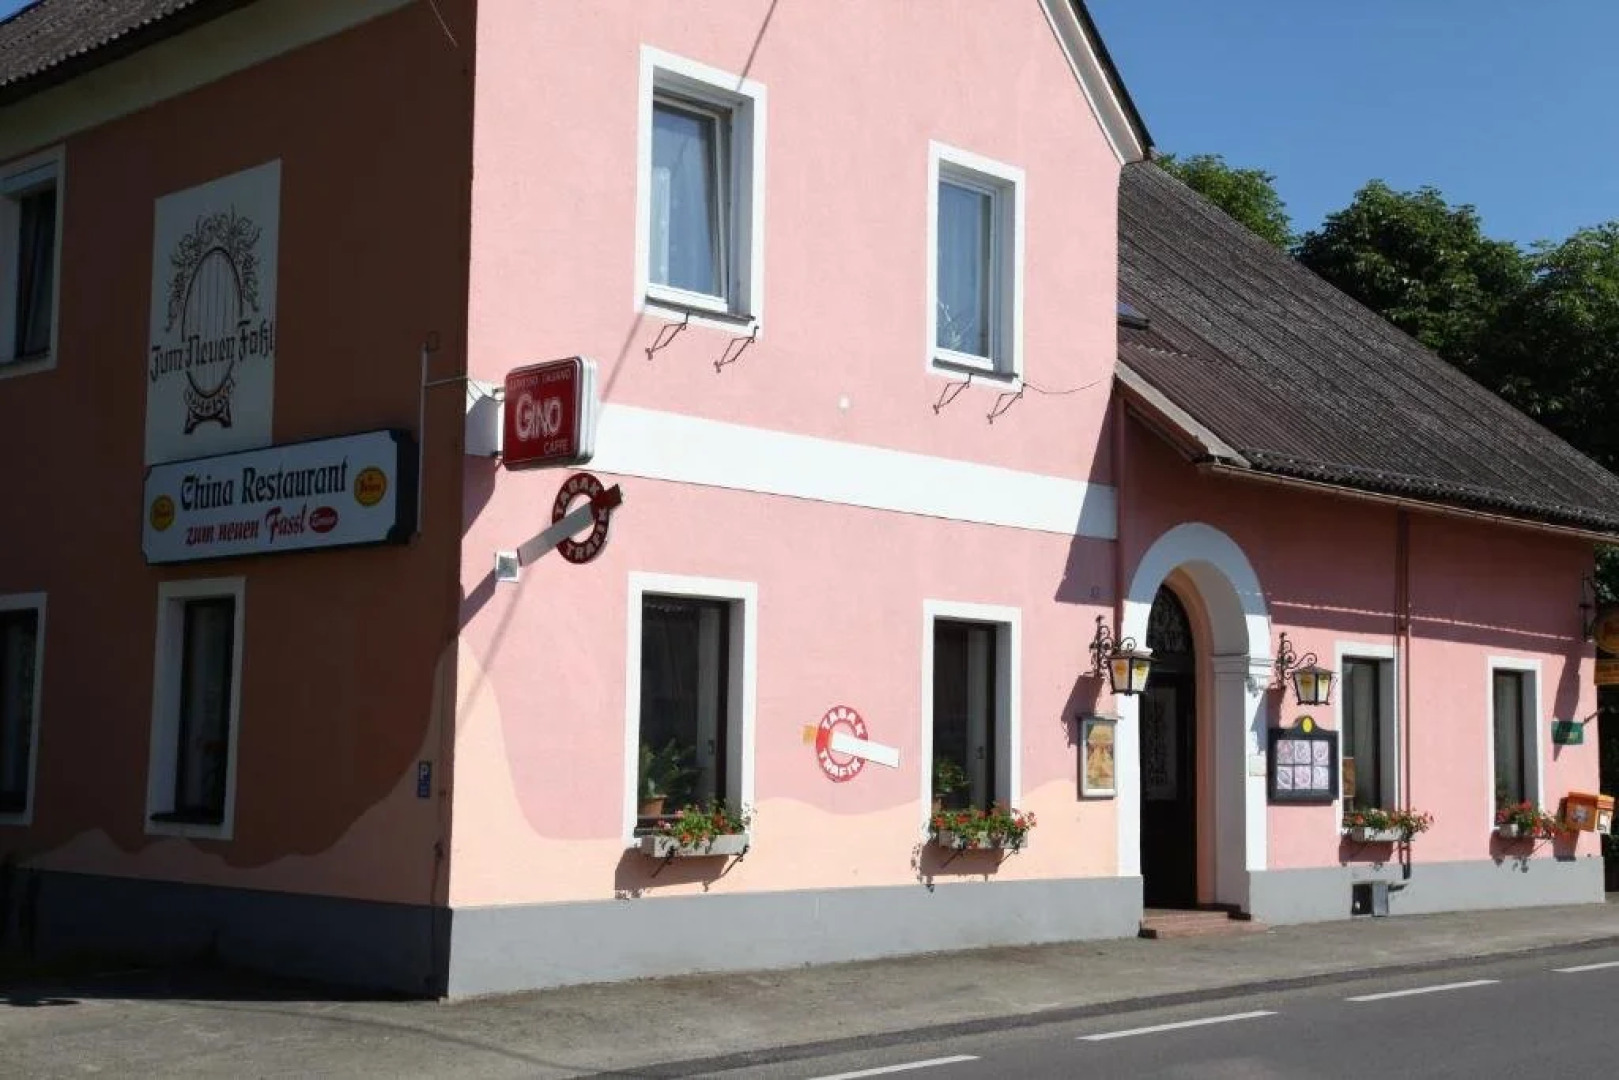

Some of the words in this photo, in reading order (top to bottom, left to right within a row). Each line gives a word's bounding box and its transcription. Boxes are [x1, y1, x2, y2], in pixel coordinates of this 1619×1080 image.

[185, 334, 235, 367] Neuen
[516, 392, 563, 442] GINO
[181, 475, 233, 511] China
[242, 456, 348, 505] Restaurant
[185, 525, 214, 547] zum
[219, 519, 260, 541] neuen
[266, 501, 308, 544] Fassl
